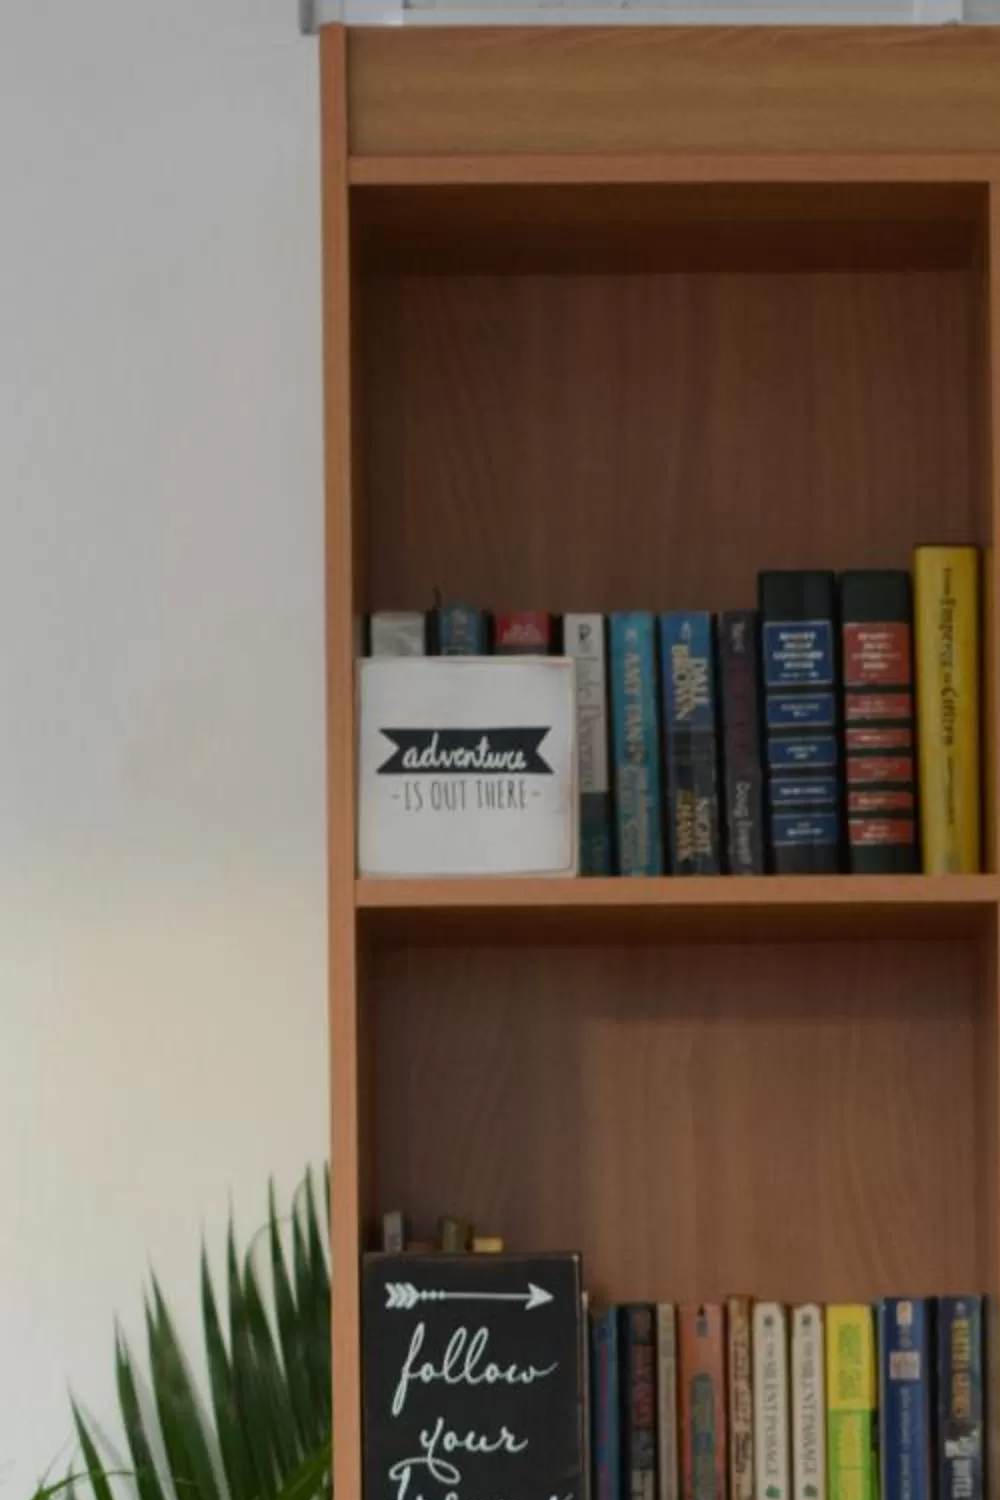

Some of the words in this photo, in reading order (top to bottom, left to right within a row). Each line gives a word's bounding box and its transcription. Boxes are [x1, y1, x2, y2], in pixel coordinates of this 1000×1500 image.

[402, 731, 527, 770] adventure
[404, 781, 424, 812] IS
[431, 780, 467, 811] OUT
[476, 780, 527, 810] THERE
[392, 1320, 560, 1418] follow
[391, 1417, 529, 1486] your
